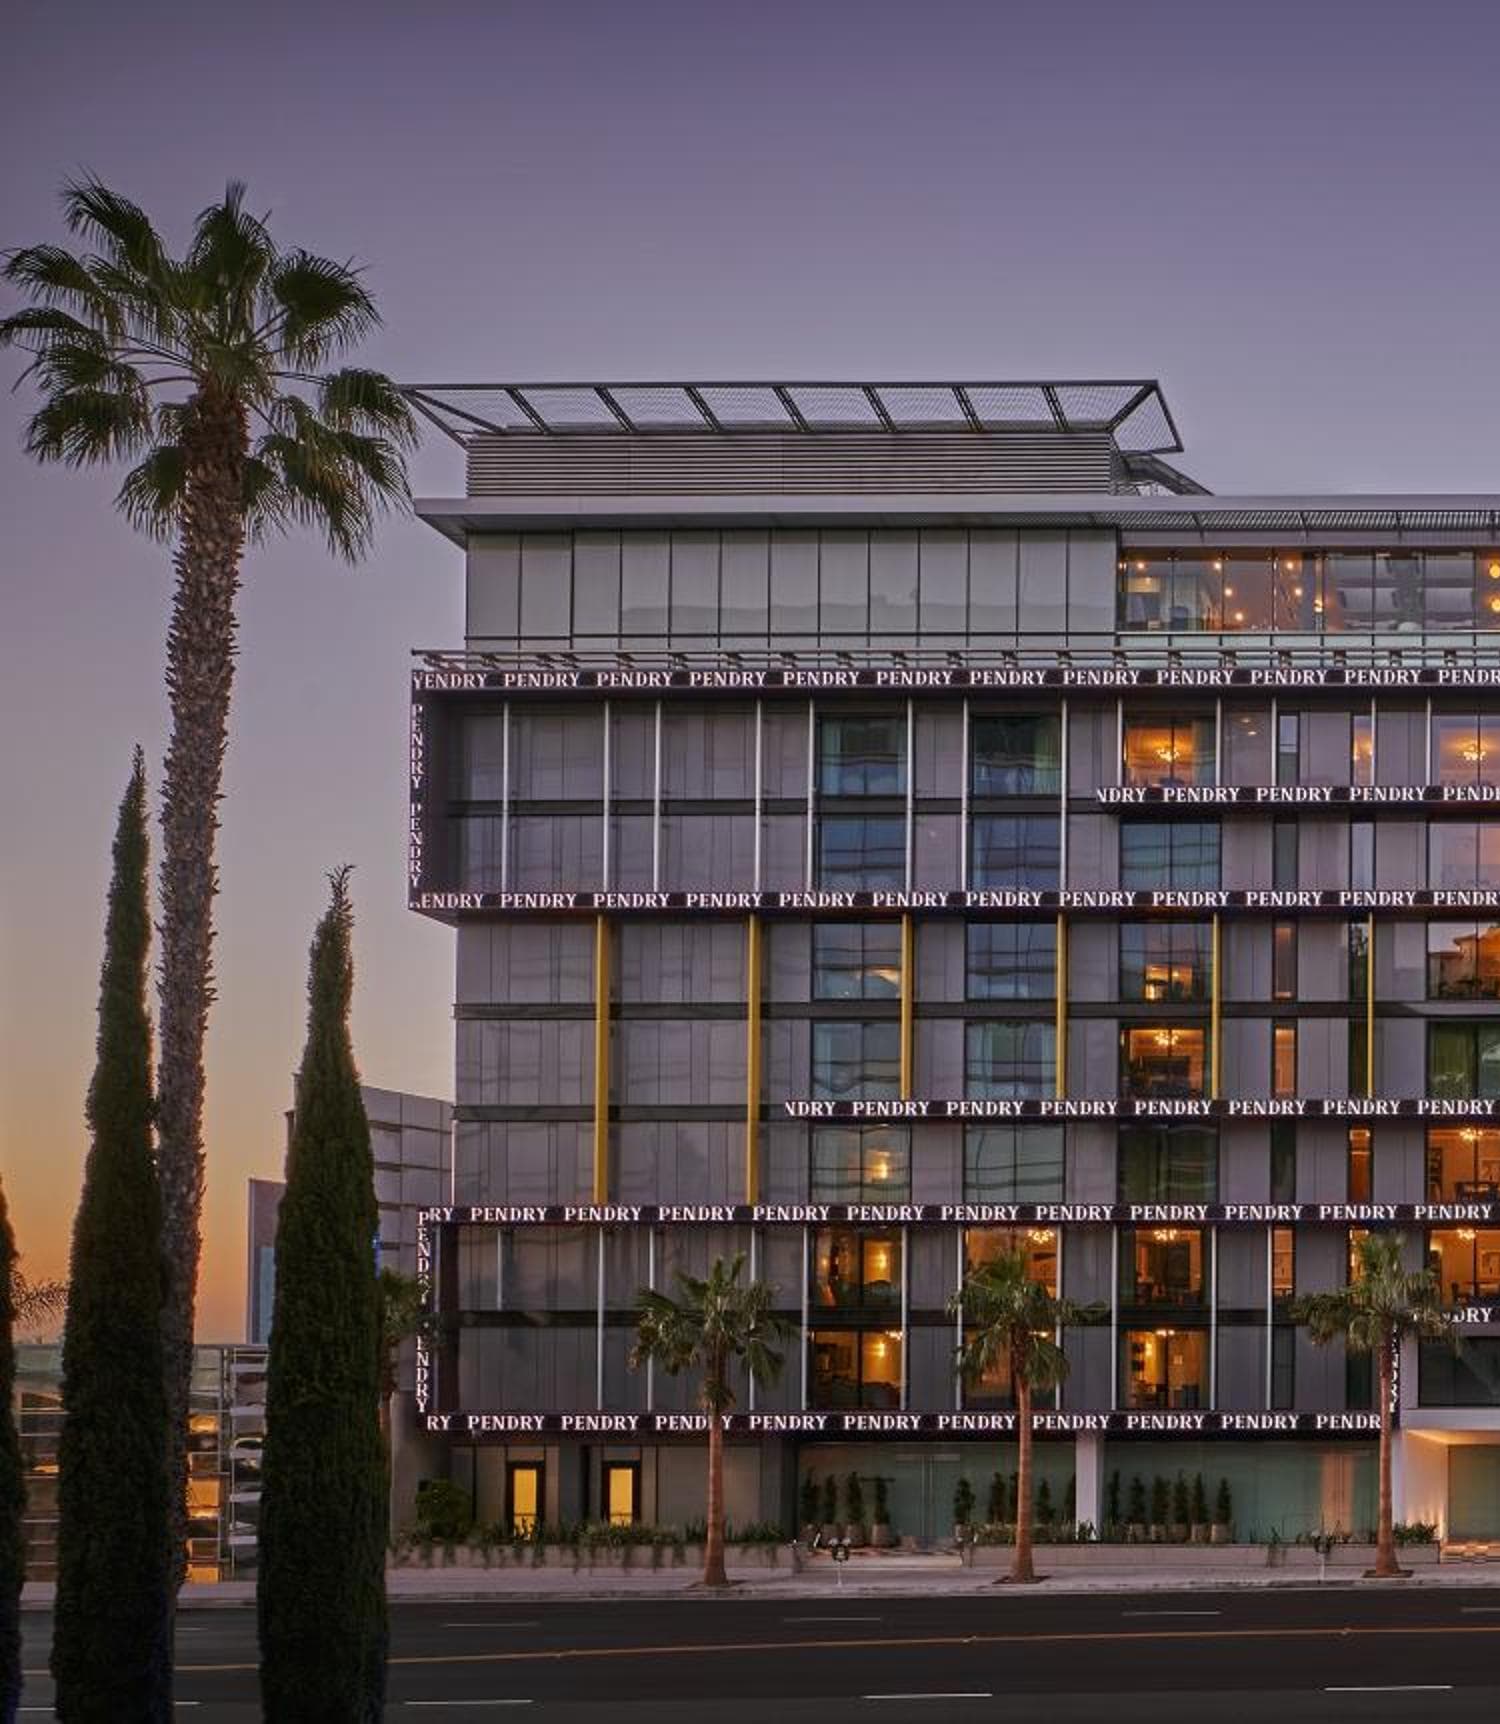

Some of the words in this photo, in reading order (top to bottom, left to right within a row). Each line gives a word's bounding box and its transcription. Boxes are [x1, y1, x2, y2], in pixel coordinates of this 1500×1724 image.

[505, 673, 579, 687] PENDRY
[597, 672, 672, 686] PENDRY
[690, 672, 765, 686] PENDRY
[784, 671, 858, 686] PENDRY
[877, 671, 952, 686] PENDRY
[970, 670, 1045, 685] PENDRY
[1064, 670, 1139, 685] PENDRY
[1157, 670, 1232, 684] PENDRY
[1251, 670, 1326, 684] PENDRY
[1344, 670, 1420, 684] PENDRY
[411, 703, 424, 789] PENDRY
[1163, 788, 1239, 802] PENDRY
[1257, 787, 1331, 802] PENDRY
[1350, 786, 1425, 801] PENDRY
[410, 803, 423, 888] PENDRY
[409, 893, 482, 908] ENDRY
[501, 893, 575, 908] PENDRY
[594, 893, 668, 908] PENDRY
[687, 893, 762, 908] PENDRY
[780, 892, 855, 907] PENDRY
[873, 892, 948, 906] PENDRY
[966, 892, 1041, 906] PENDRY
[1060, 892, 1135, 906] PENDRY
[1152, 892, 1228, 906] PENDRY
[1246, 892, 1322, 906] PENDRY
[1340, 891, 1415, 906] PENDRY
[853, 1101, 928, 1116] PENDRY
[947, 1101, 1022, 1116] PENDRY
[1041, 1101, 1116, 1115] PENDRY
[1135, 1100, 1211, 1115] PENDRY
[1229, 1100, 1305, 1115] PENDRY
[1324, 1100, 1399, 1114] PENDRY
[1418, 1100, 1494, 1114] PENDRY
[471, 1207, 546, 1221] PENDRY
[565, 1207, 640, 1221] PENDRY
[659, 1206, 735, 1221] PENDRY
[753, 1206, 828, 1220] PENDRY
[848, 1206, 923, 1220] PENDRY
[941, 1206, 1018, 1220] PENDRY
[1036, 1206, 1112, 1220] PENDRY
[1131, 1206, 1207, 1220] PENDRY
[1226, 1205, 1301, 1220] PENDRY
[1320, 1205, 1396, 1220] PENDRY
[1415, 1204, 1491, 1219] PENDRY
[416, 1321, 430, 1413] NDRY
[428, 1415, 450, 1430] RY
[468, 1415, 544, 1430] PENDRY
[562, 1415, 638, 1430] PENDRY
[656, 1415, 732, 1430] PENDY
[750, 1415, 826, 1430] PENDRY
[845, 1415, 920, 1430] PENDRY
[939, 1415, 1015, 1429] PENDRY
[1033, 1415, 1108, 1429] PENDRY
[1128, 1415, 1203, 1429] PENDRY
[1222, 1415, 1298, 1429] PENDRY
[1317, 1415, 1382, 1429] PENDR
